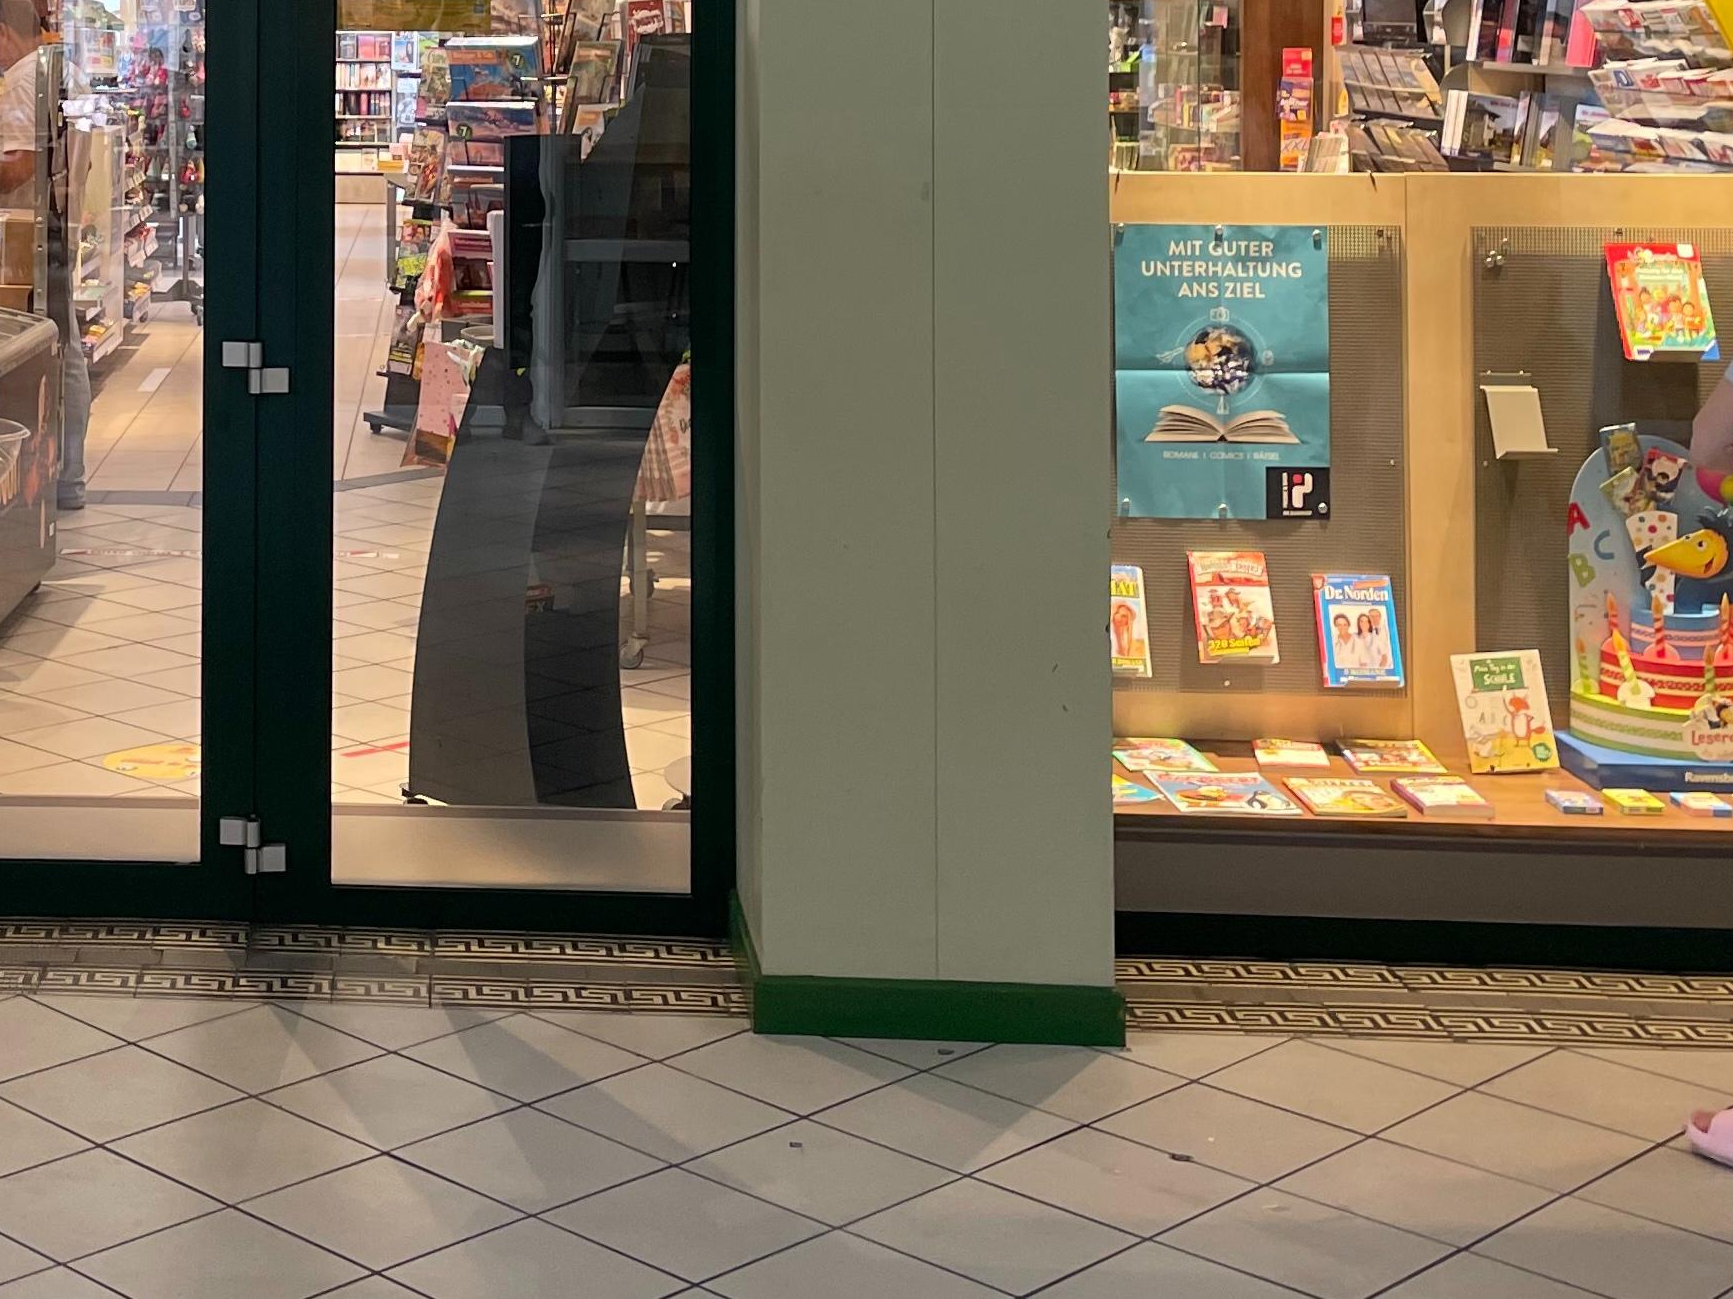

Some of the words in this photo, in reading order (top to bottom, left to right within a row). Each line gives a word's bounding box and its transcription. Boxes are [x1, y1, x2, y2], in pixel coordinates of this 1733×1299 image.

[1169, 240, 1203, 256] MIT
[1208, 241, 1274, 257] GUTER
[1141, 261, 1302, 278] UNTERHALTUNG
[1178, 282, 1218, 298] ANS
[1224, 282, 1265, 298] ZIEL
[1324, 585, 1343, 600] Dr.
[1344, 585, 1389, 601] Norden
